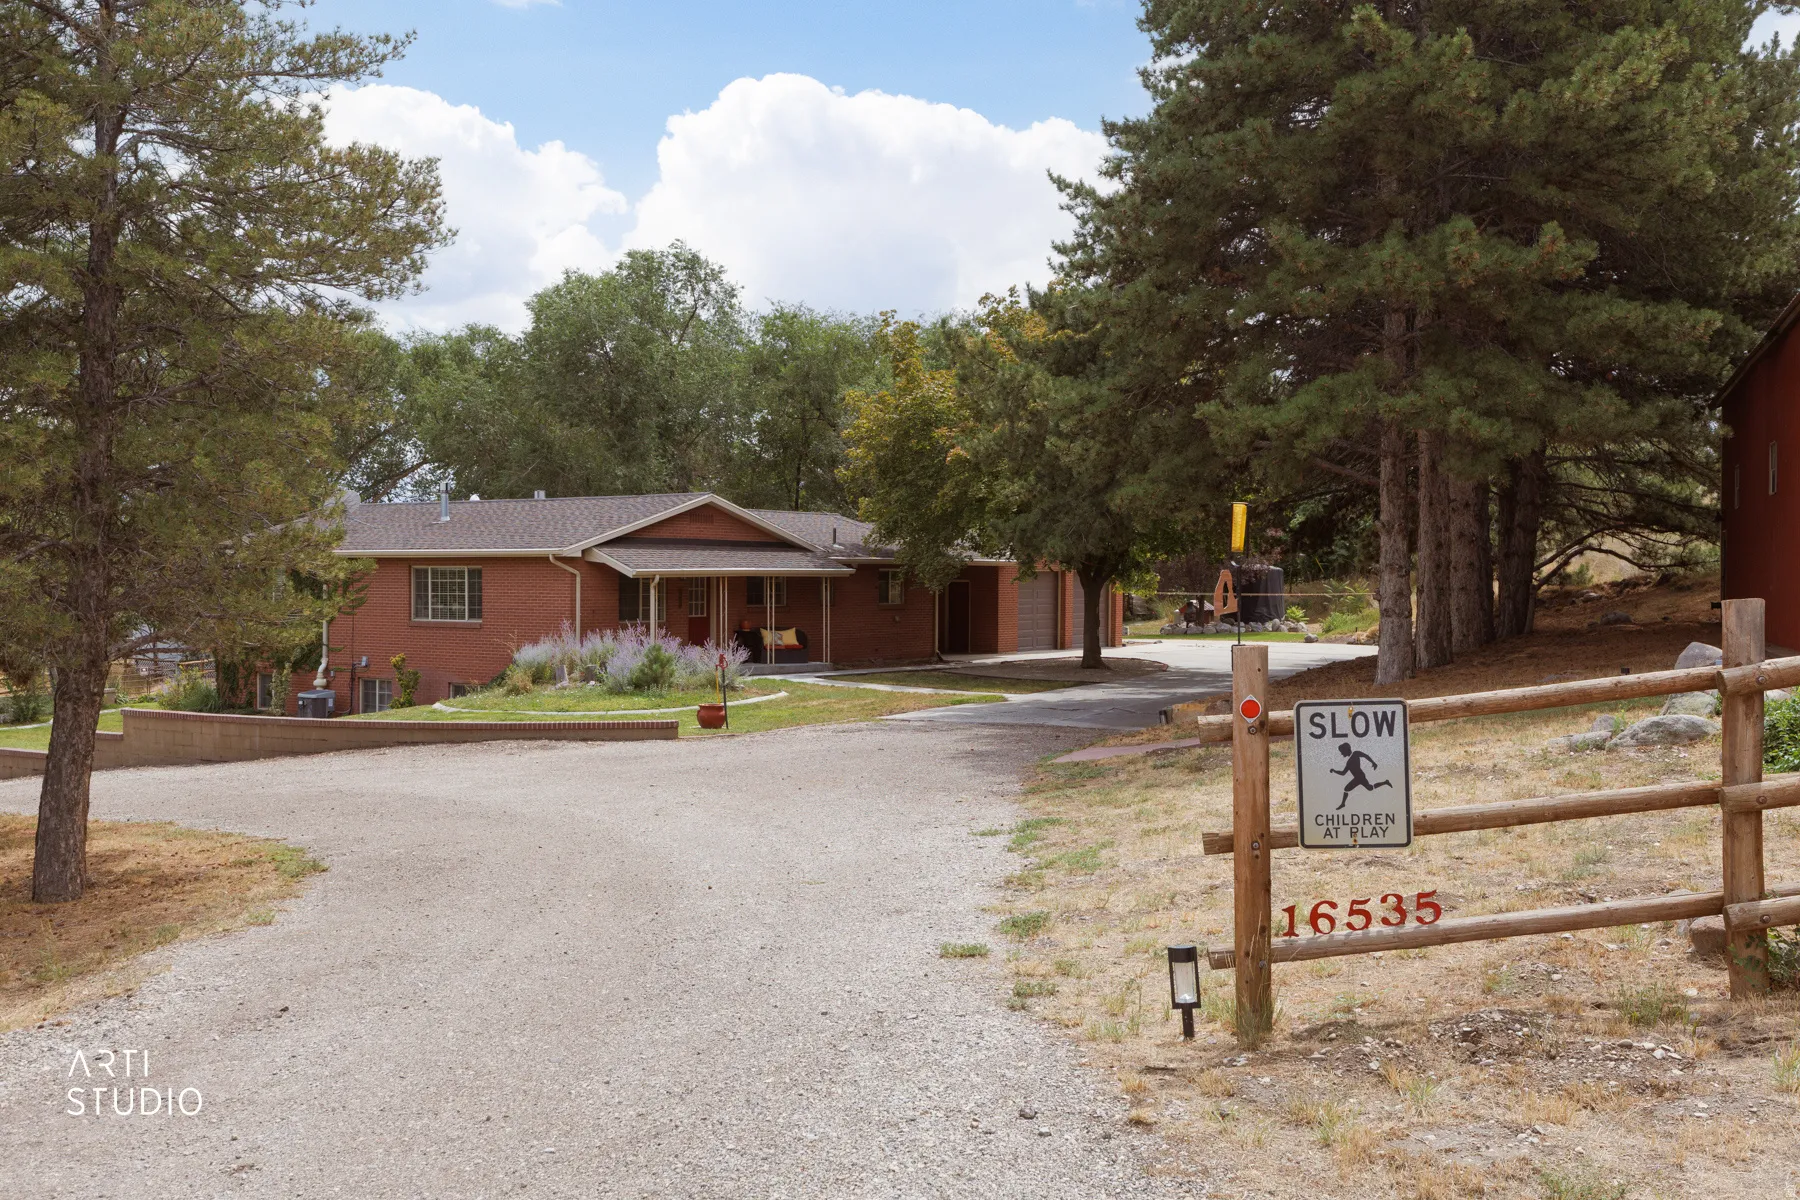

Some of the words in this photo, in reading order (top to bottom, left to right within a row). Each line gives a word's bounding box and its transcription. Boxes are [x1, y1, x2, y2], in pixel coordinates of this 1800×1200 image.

[1308, 710, 1396, 739] SLOW
[1315, 812, 1395, 826] CHILDREN
[1323, 826, 1341, 839] AT
[1349, 826, 1389, 839] PLAY
[1282, 889, 1442, 937] 16535
